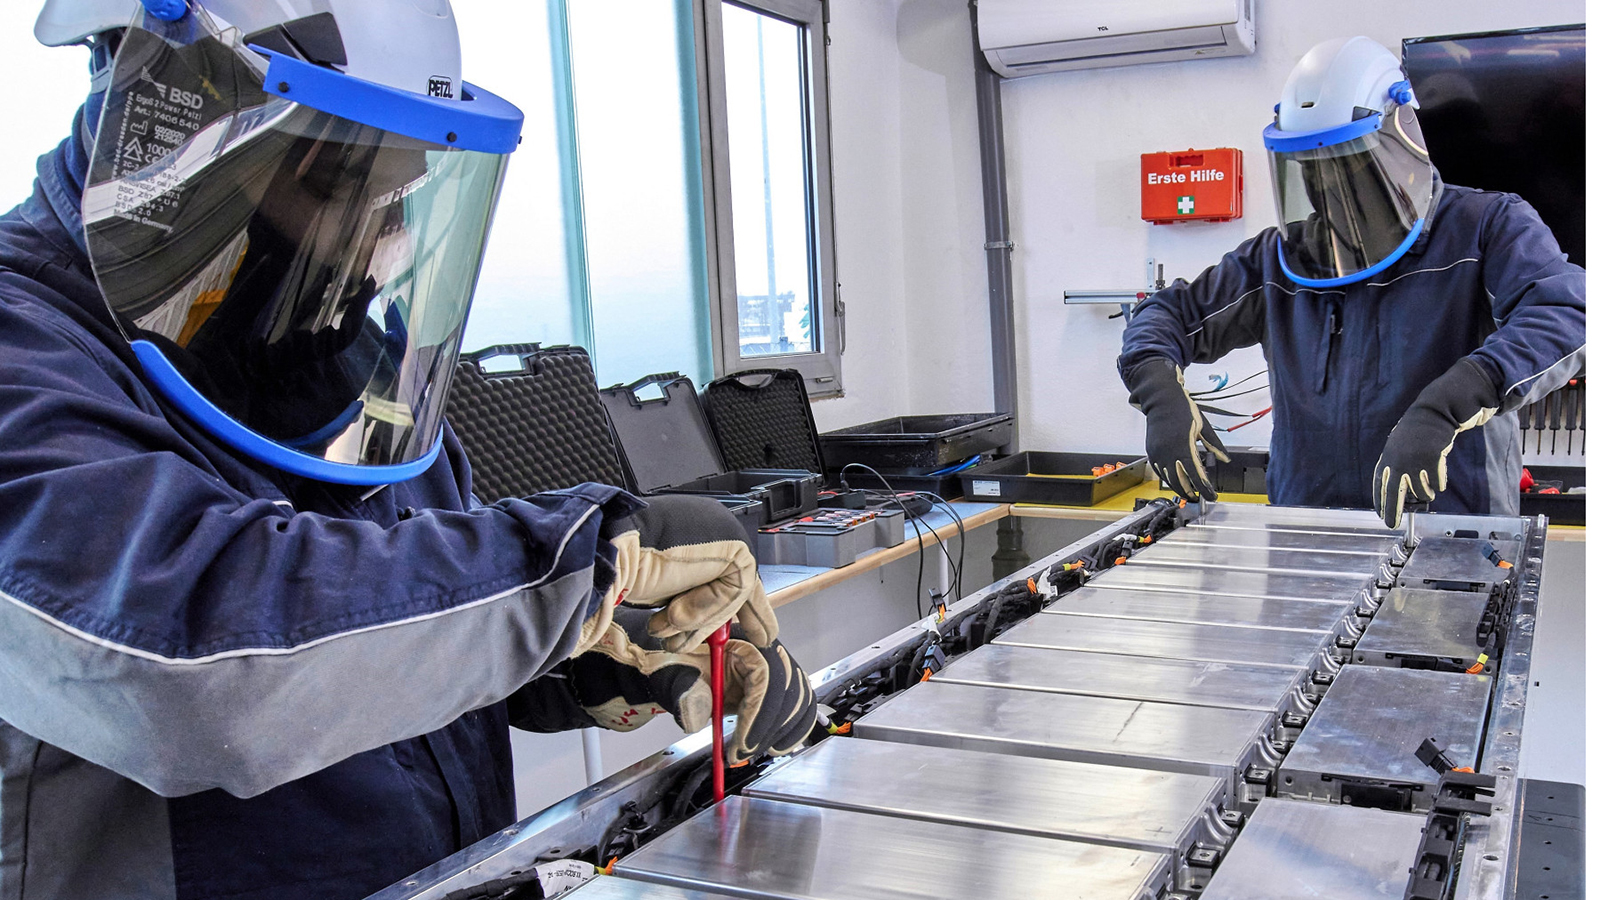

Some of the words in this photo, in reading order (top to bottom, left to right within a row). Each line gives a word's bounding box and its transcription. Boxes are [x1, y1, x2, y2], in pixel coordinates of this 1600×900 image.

[428, 79, 453, 98] PETZL
[169, 88, 203, 109] BSD
[160, 101, 182, 114] Power
[1147, 172, 1187, 185] Erste
[1190, 169, 1225, 182] Hilfe
